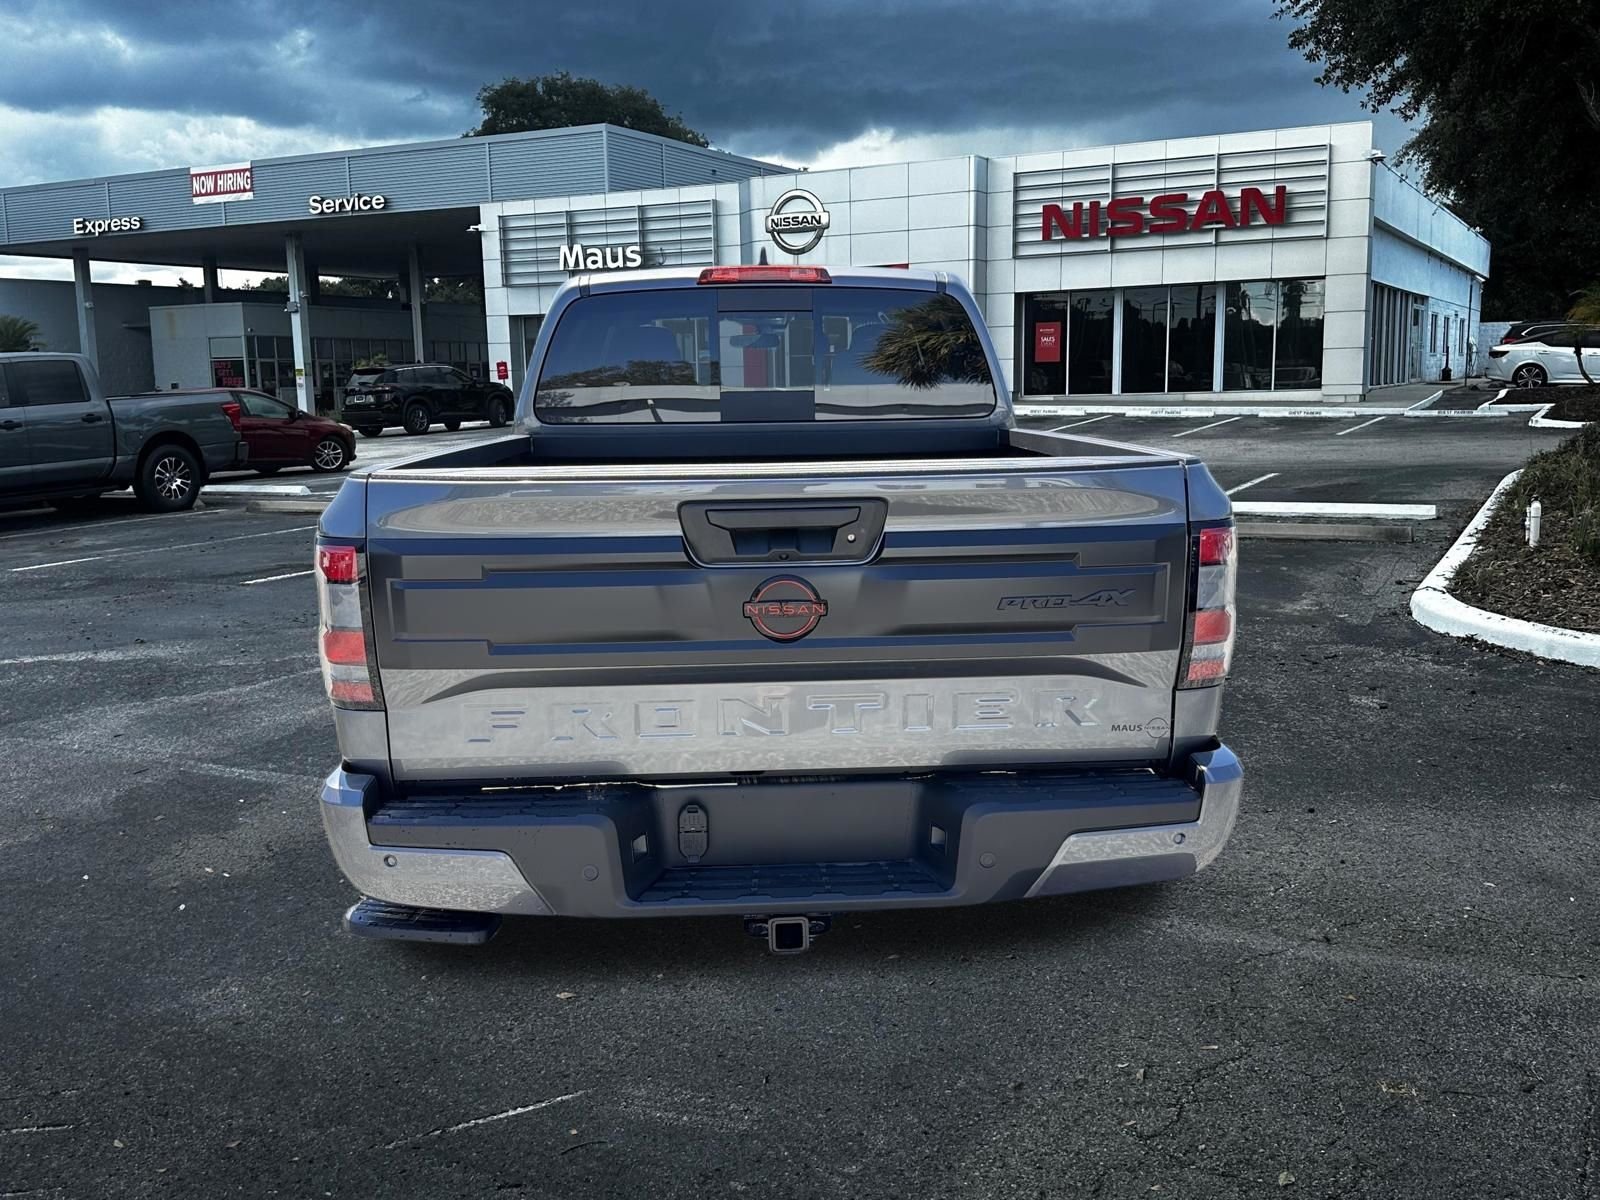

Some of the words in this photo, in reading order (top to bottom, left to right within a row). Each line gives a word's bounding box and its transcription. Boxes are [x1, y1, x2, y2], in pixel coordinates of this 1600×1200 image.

[192, 174, 215, 195] NOW
[217, 171, 251, 192] HIRING
[308, 193, 386, 215] Service
[1041, 185, 1287, 241] NISSAN
[73, 216, 141, 237] Express
[770, 214, 822, 229] NISSAN
[559, 243, 643, 271] Maus
[746, 603, 825, 615] NISSAN
[997, 588, 1136, 611] PRO-4X
[463, 687, 1100, 743] FRONTIER
[1111, 724, 1143, 732] MAUS
